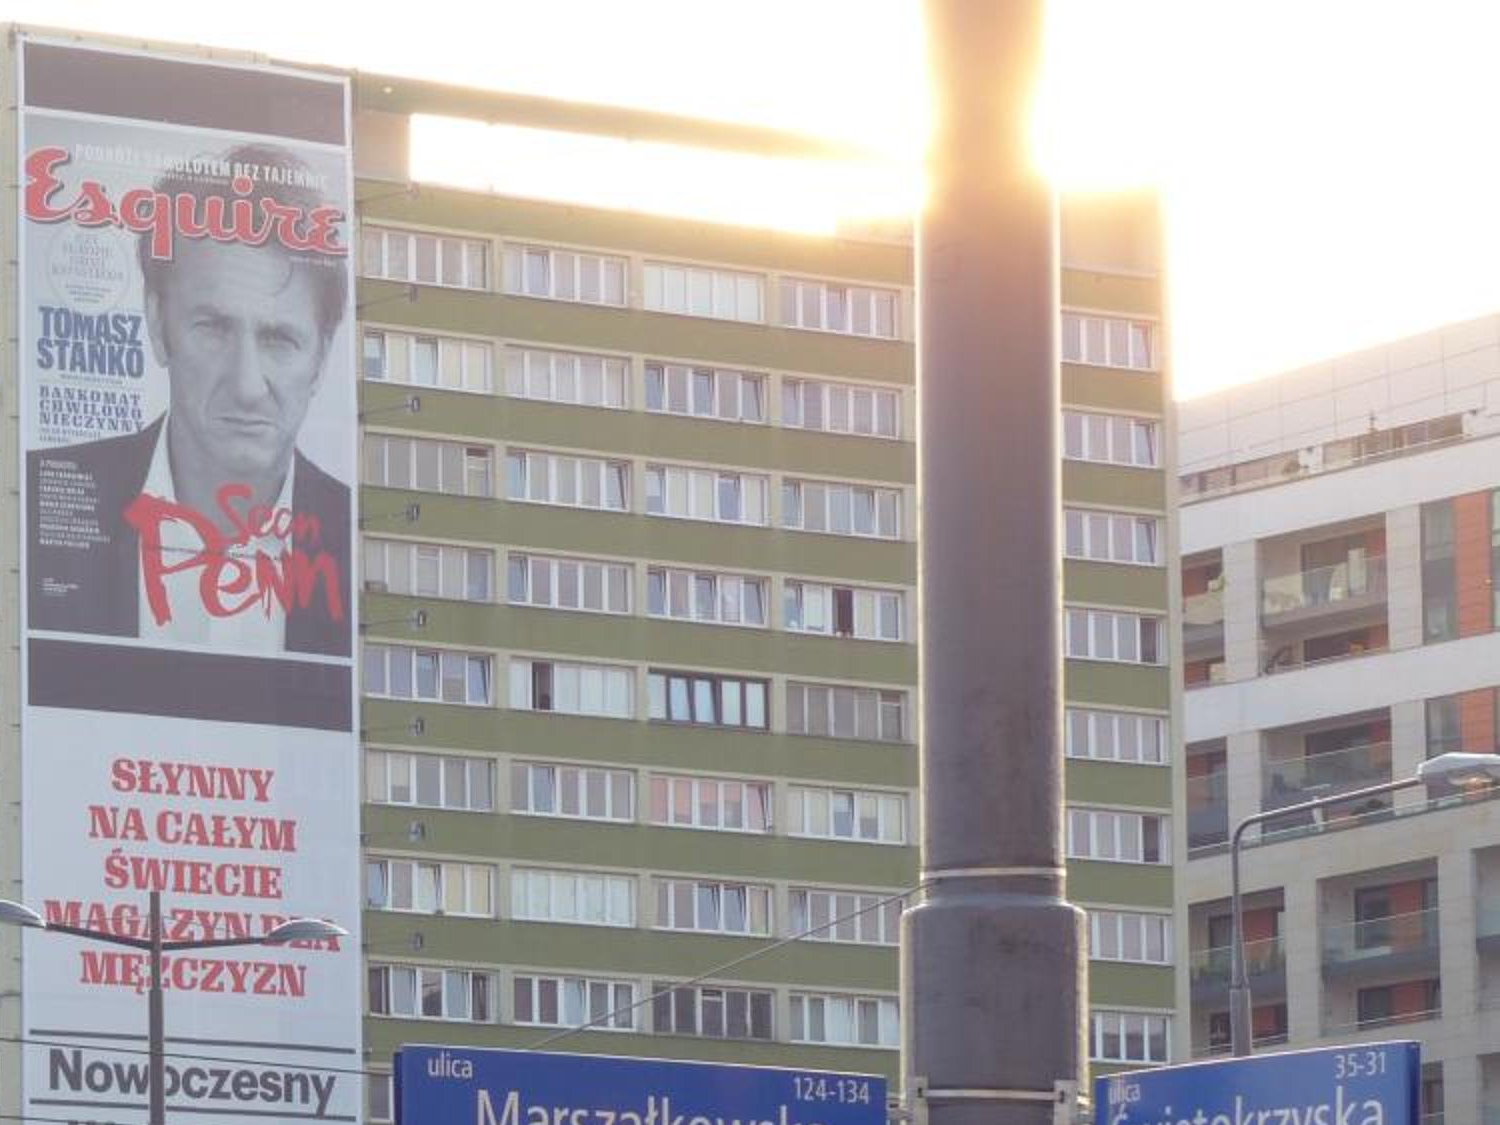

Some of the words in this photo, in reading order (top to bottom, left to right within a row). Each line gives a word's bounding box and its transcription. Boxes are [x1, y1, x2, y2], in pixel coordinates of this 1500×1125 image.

[25, 147, 348, 260] Esquire
[38, 306, 142, 346] TOMASZ
[111, 758, 275, 802] SŁYNNY
[88, 805, 149, 841] NA
[155, 810, 297, 852] CAŁYM
[104, 848, 283, 899] ŚWIECIE
[49, 1048, 337, 1119] Nowoczesny
[427, 1053, 473, 1080] ulica
[793, 1076, 870, 1105] 124-134
[1109, 1081, 1141, 1105] ulica
[1334, 1051, 1386, 1079] 35-31
